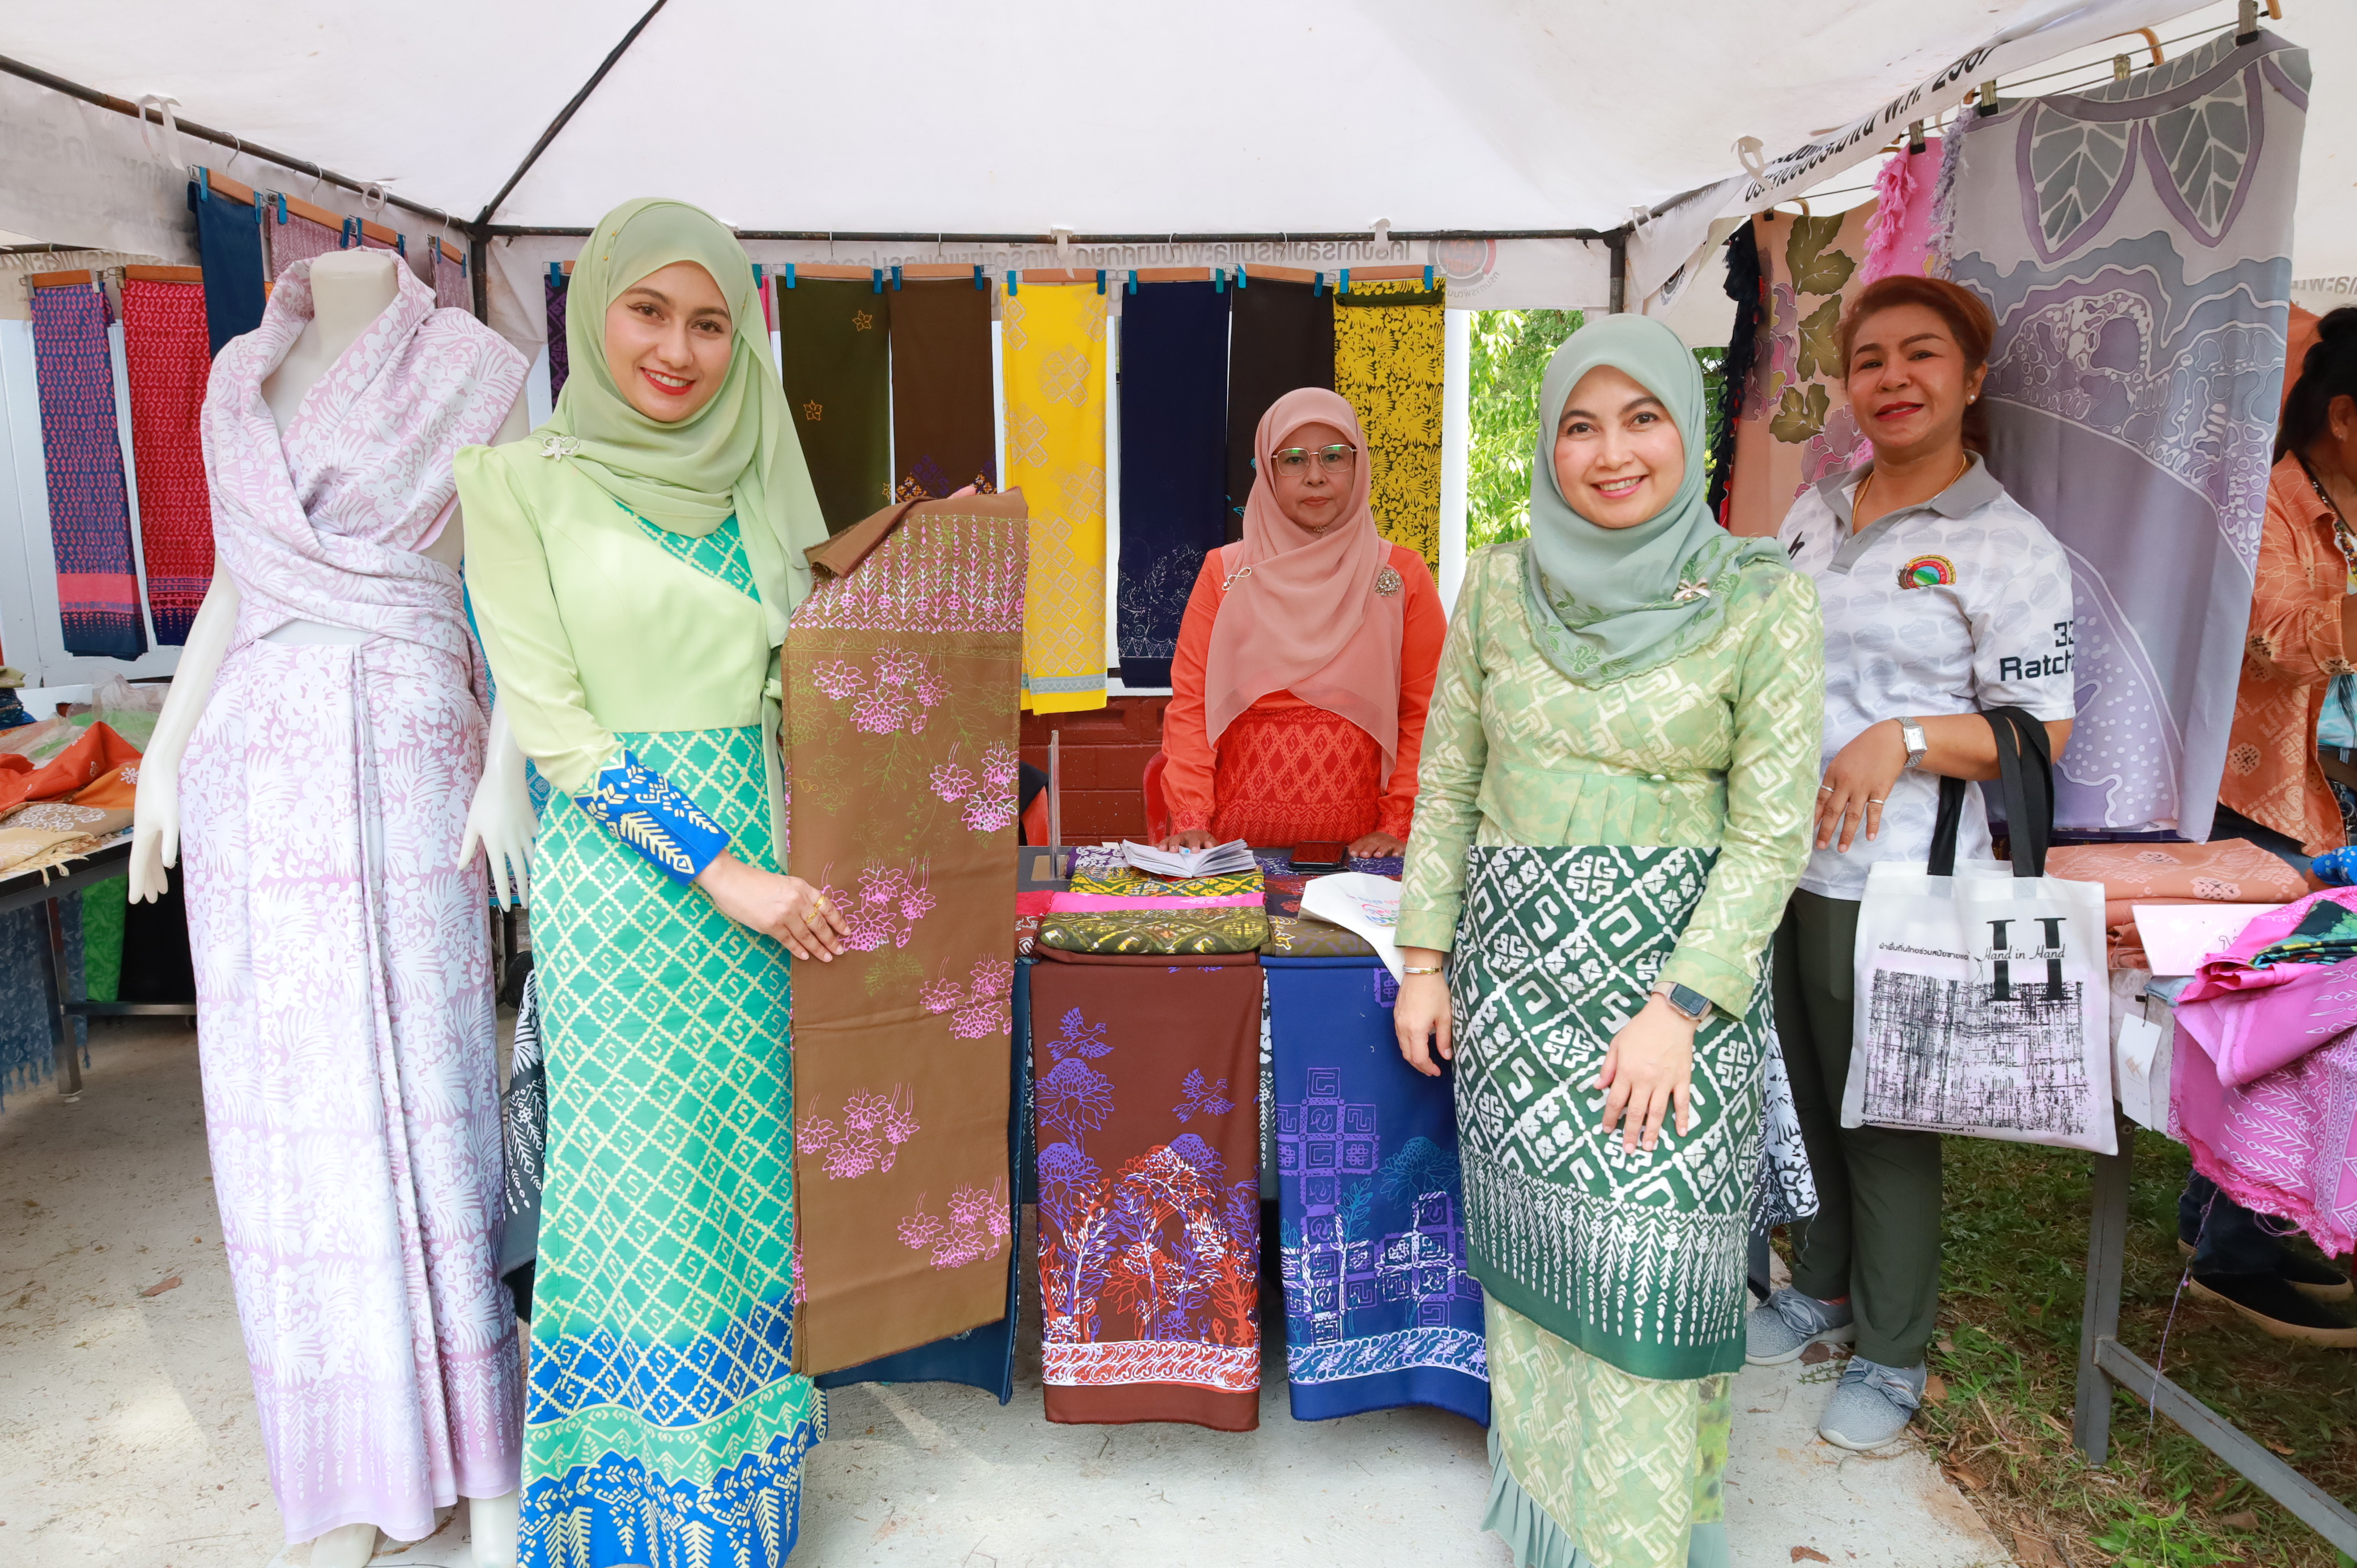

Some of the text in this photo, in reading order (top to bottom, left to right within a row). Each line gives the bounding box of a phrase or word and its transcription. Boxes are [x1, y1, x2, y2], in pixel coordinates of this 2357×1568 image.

[1981, 943, 2066, 961] Hand in Hand
